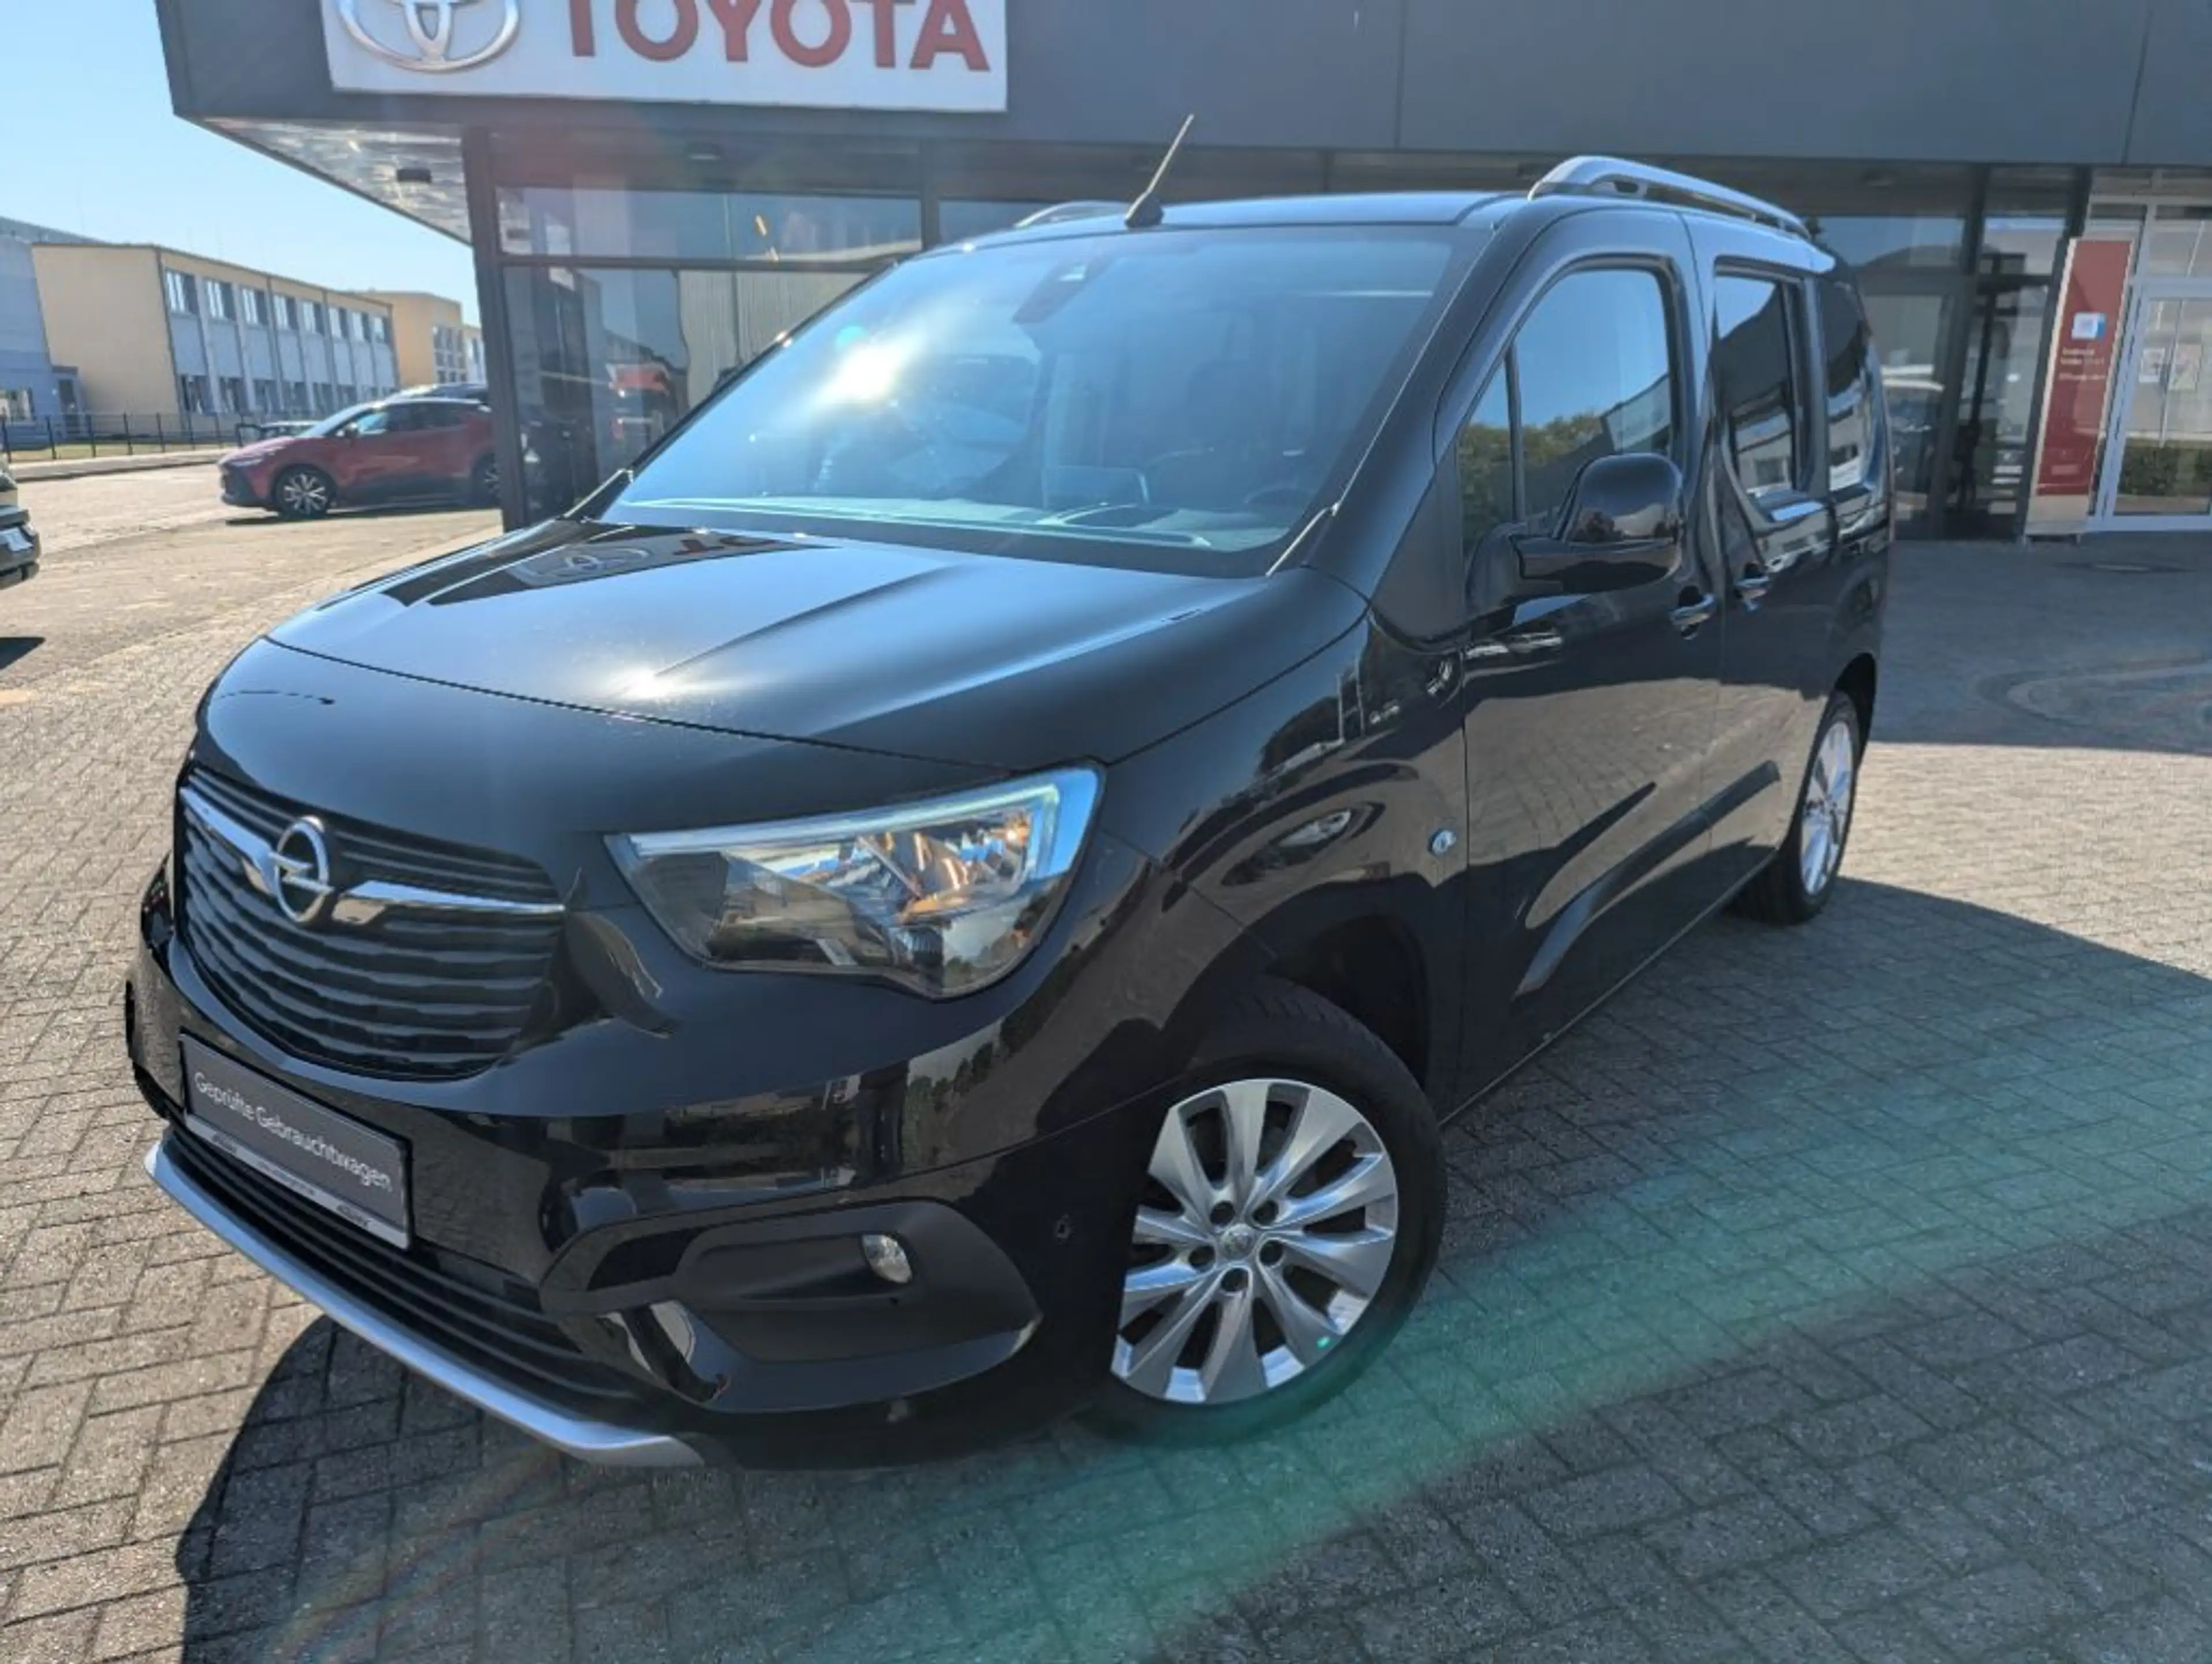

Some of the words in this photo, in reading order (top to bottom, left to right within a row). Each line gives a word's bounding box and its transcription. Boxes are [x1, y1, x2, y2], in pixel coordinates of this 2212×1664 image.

[569, 0, 990, 72] TOYOTA
[195, 1072, 255, 1121] Geprüfte
[255, 1106, 393, 1193] Gebrauchtwagen
